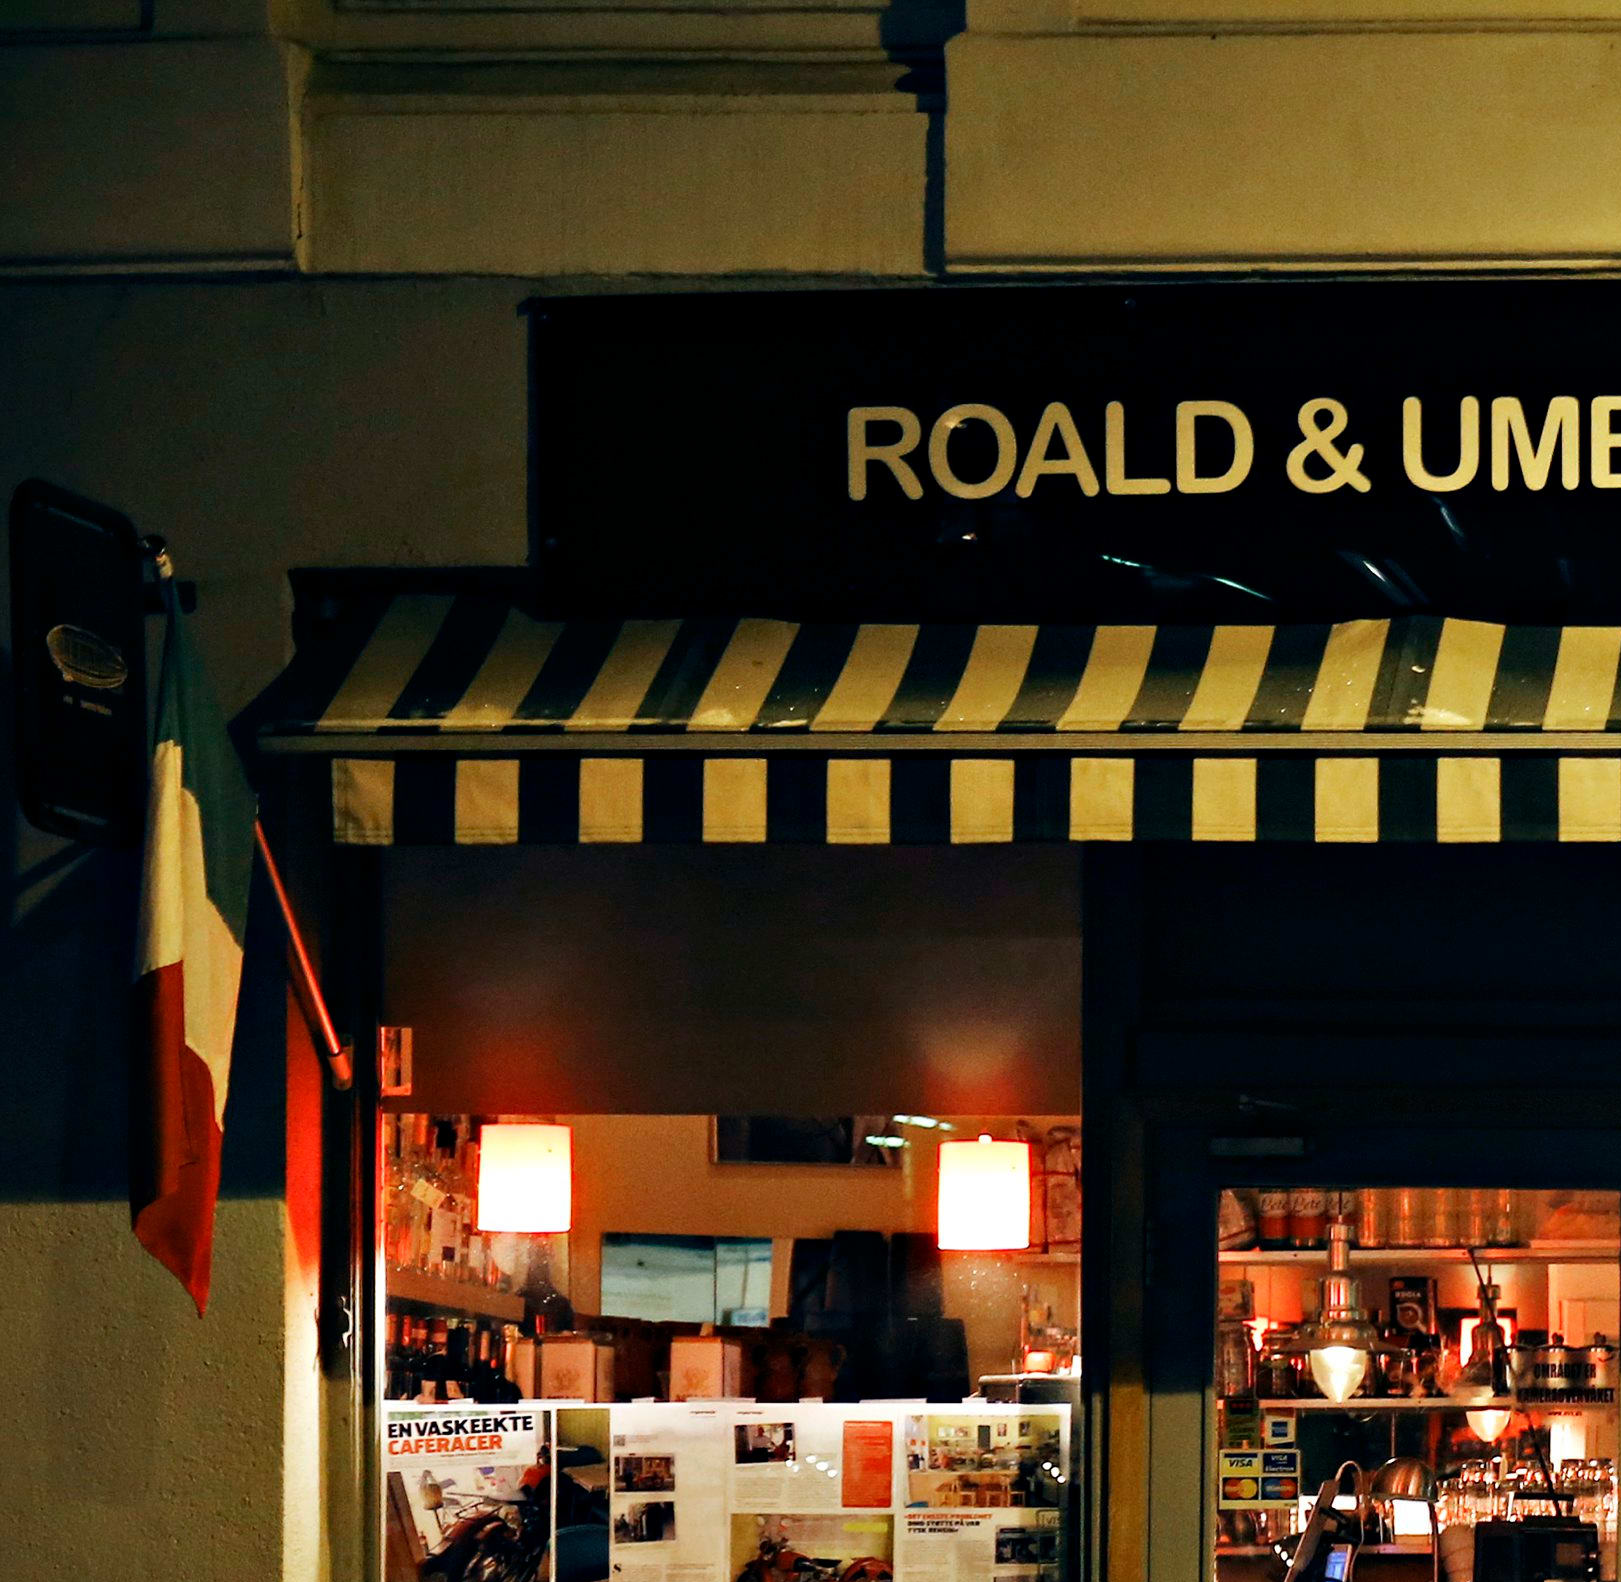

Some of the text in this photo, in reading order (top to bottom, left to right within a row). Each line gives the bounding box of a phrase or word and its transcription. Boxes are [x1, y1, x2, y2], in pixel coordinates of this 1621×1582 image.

[847, 400, 1255, 501] ROALD
[1285, 397, 1372, 495] &
[1585, 1363, 1597, 1378] ER
[387, 1415, 534, 1438] EN VASKEEKTE
[388, 1434, 503, 1456] CAFERACER
[1229, 1459, 1253, 1468] VISA
